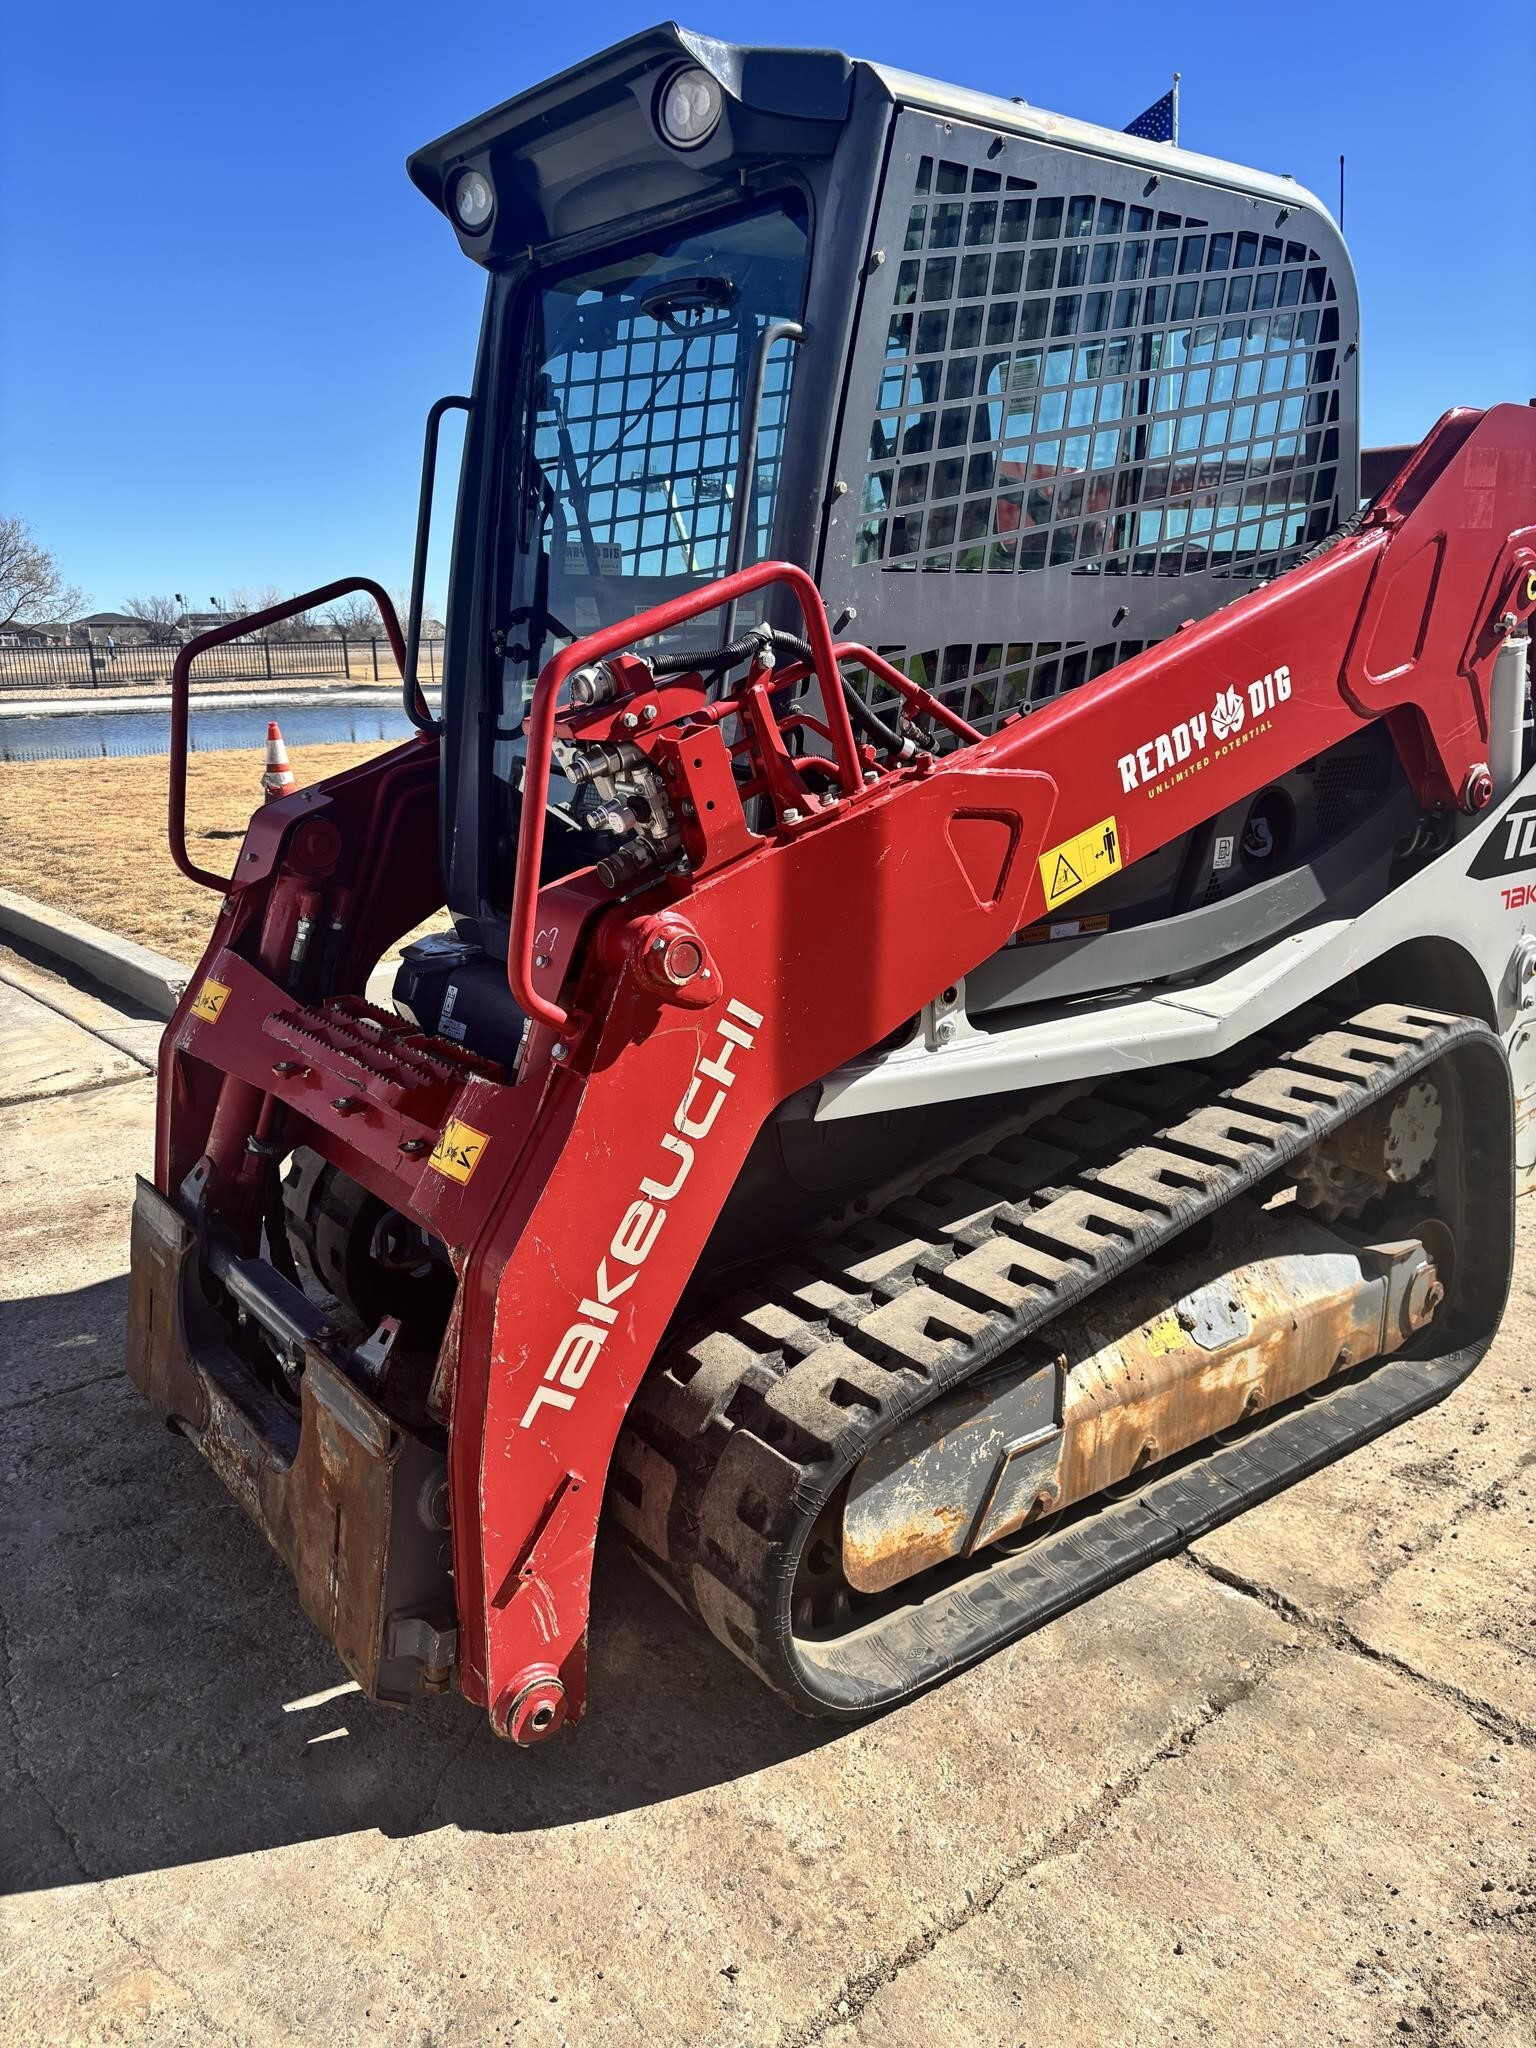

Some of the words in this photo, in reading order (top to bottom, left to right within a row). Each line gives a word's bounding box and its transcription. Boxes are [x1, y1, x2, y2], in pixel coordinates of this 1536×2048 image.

[1117, 711, 1208, 794] READY
[1247, 665, 1292, 718] DIG
[1148, 757, 1210, 799] UNLIMITED
[1214, 720, 1273, 760] POTENTIAL
